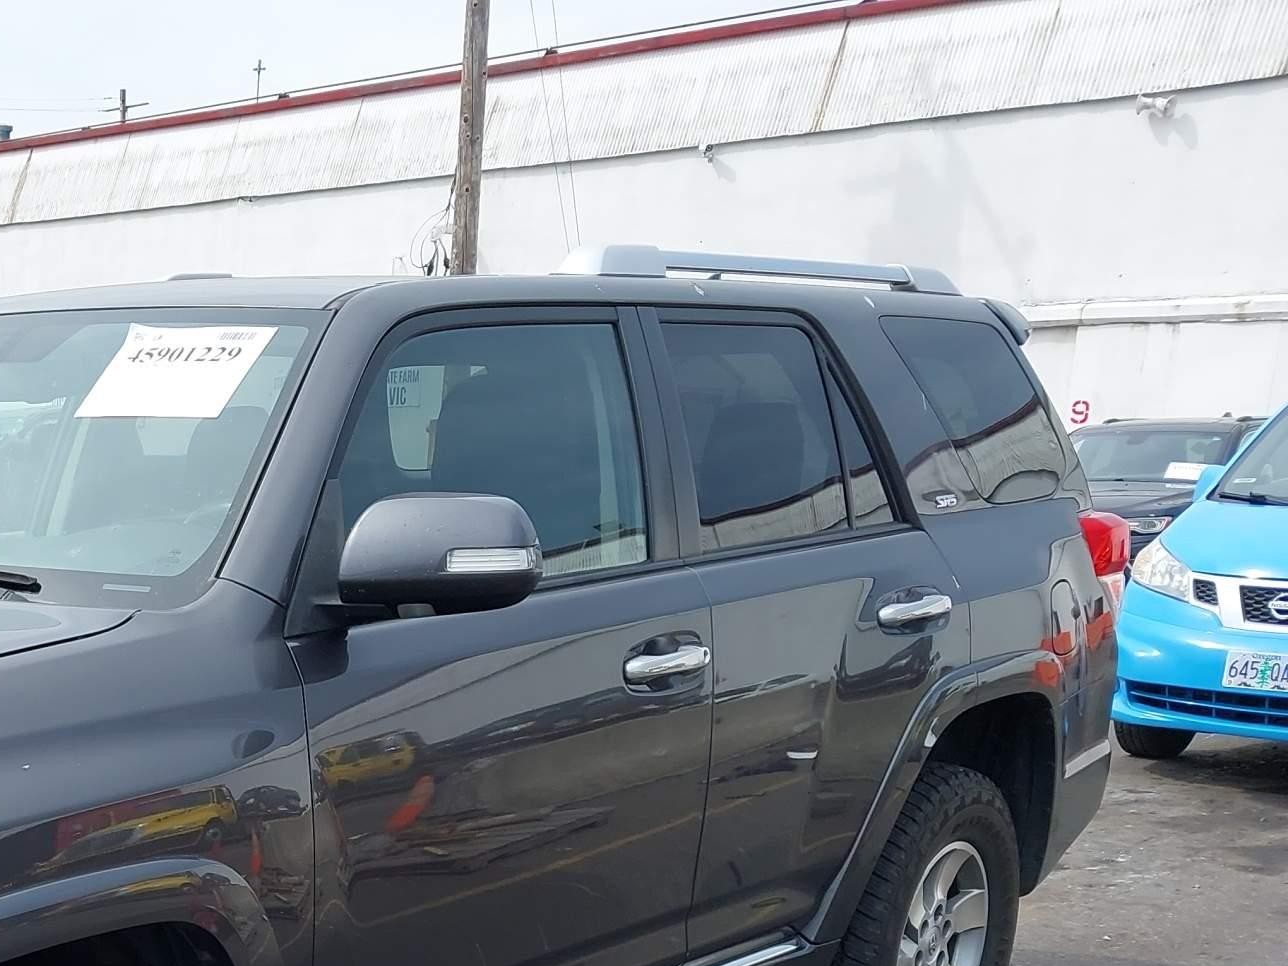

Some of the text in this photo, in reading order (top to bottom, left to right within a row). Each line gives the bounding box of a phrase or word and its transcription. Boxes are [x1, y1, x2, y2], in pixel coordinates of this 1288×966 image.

[127, 346, 243, 364] 45901229
[399, 370, 420, 384] FARM
[389, 386, 407, 406] VIC
[1070, 400, 1090, 425] 9
[1229, 659, 1261, 680] 645
